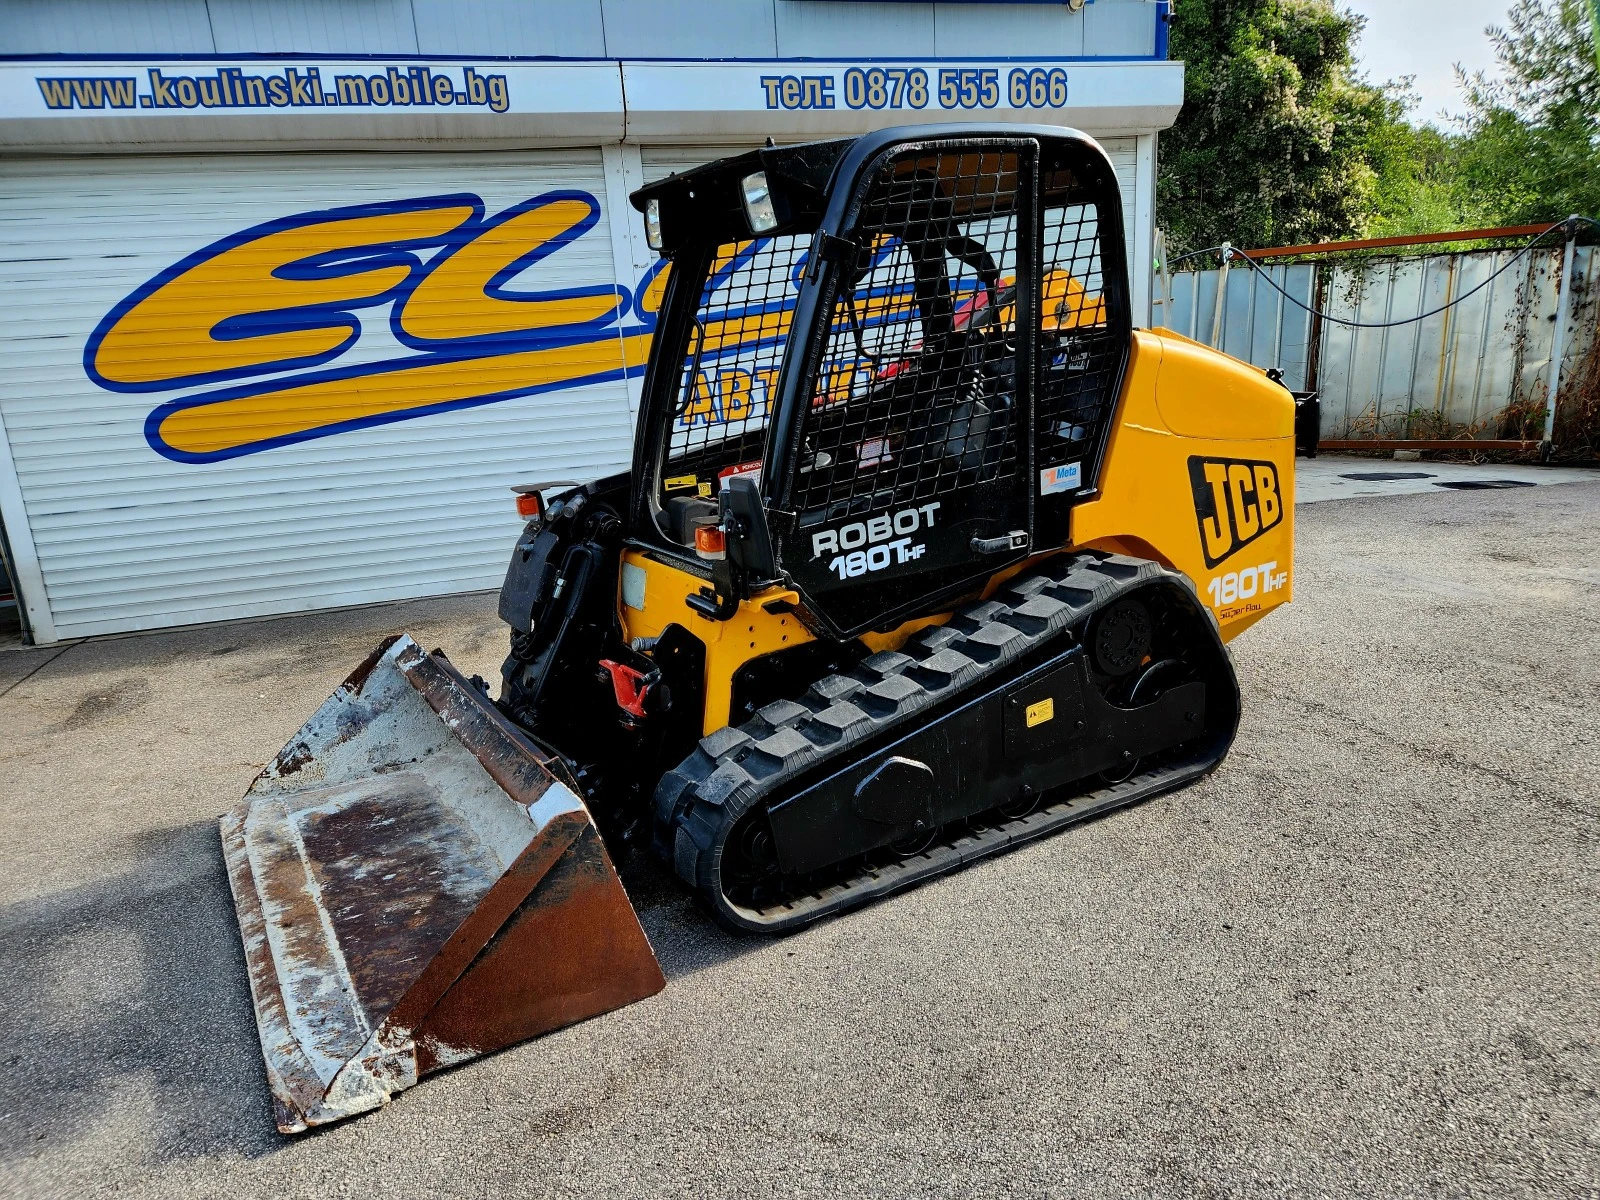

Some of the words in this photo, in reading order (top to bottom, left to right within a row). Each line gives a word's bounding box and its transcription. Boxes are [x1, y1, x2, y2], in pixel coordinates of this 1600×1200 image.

[36, 67, 510, 113] www.koulinski.mobile.bg
[761, 75, 835, 109] тел:
[843, 67, 929, 110] 0878
[938, 68, 999, 110] 555
[1007, 67, 1068, 110] 666
[1056, 467, 1077, 479] Meta
[812, 502, 941, 558] ROBOT
[1203, 463, 1280, 560] JCB
